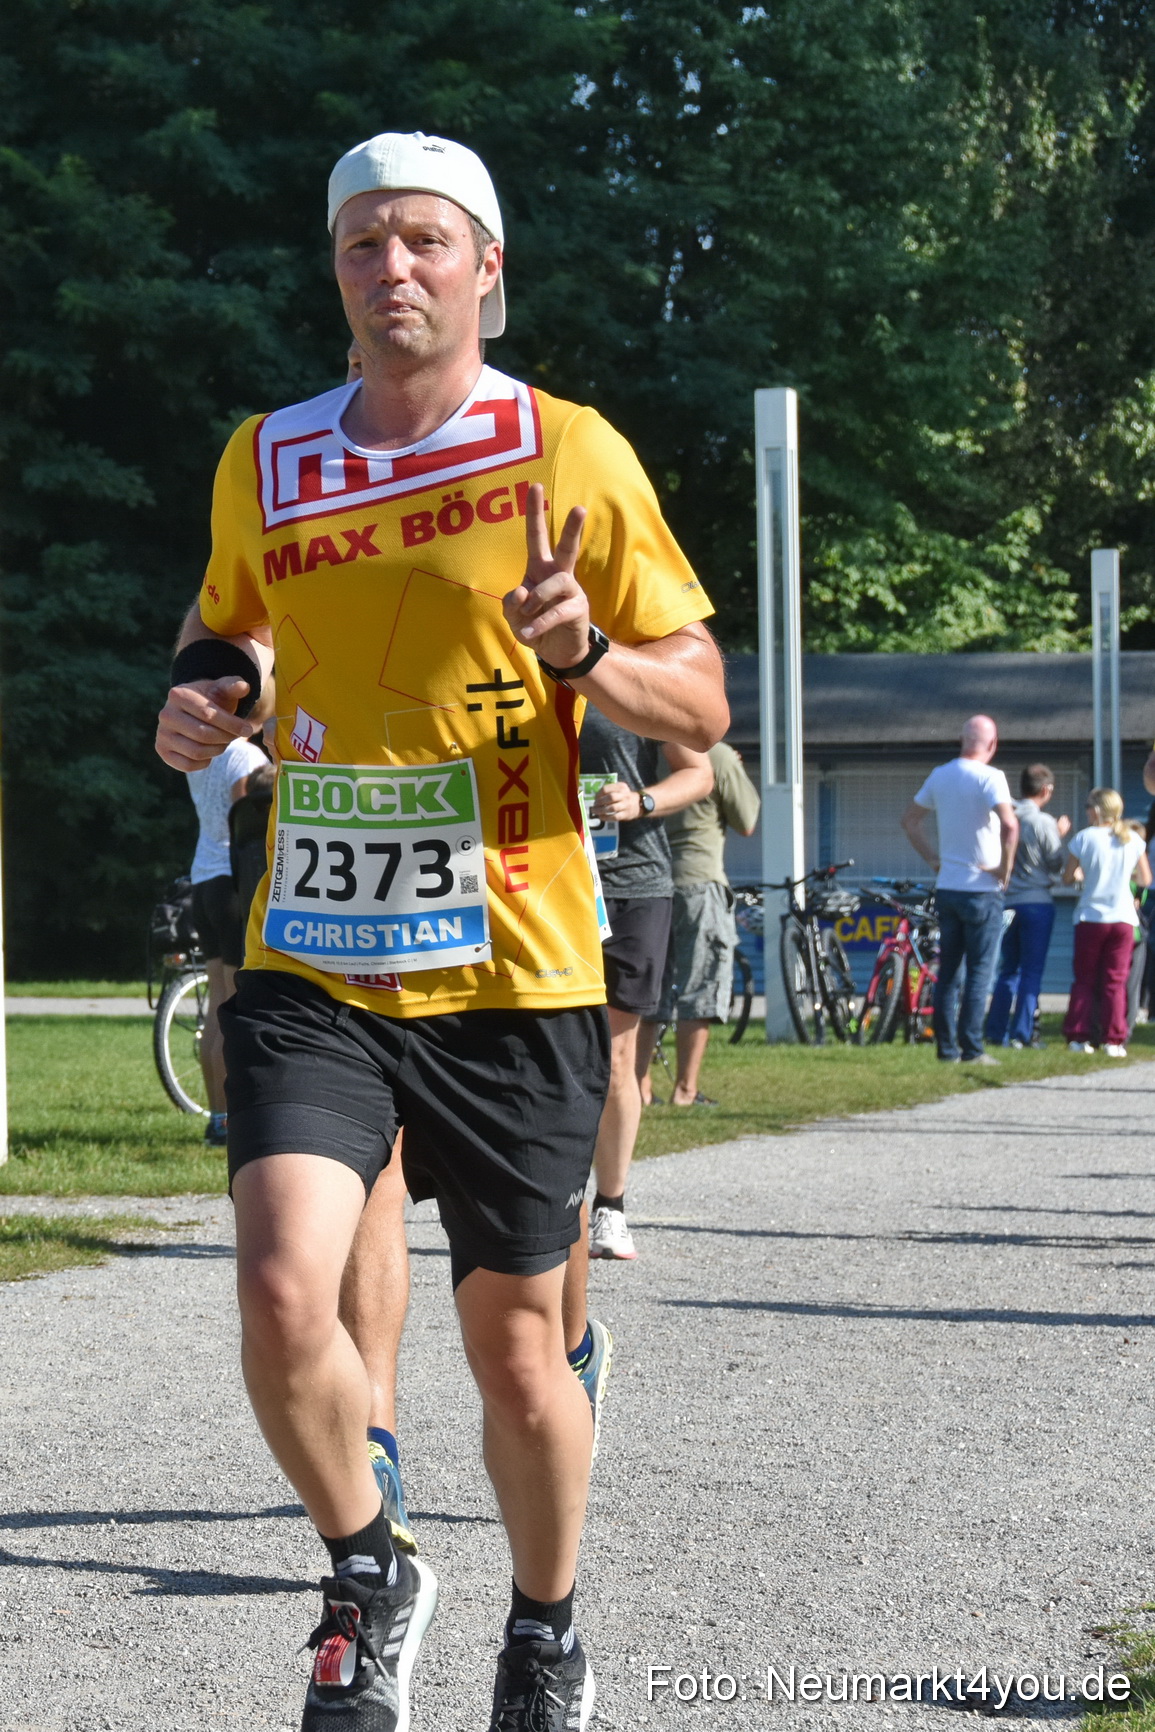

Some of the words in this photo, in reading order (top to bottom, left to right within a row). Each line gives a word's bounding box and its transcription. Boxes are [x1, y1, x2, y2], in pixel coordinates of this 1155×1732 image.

[262, 523, 382, 587] MAX
[400, 480, 549, 548] BÖGL
[289, 772, 455, 820] BOCK
[461, 840, 471, 851] C
[294, 838, 455, 902] 2373
[283, 916, 463, 949] CHRISTIAN
